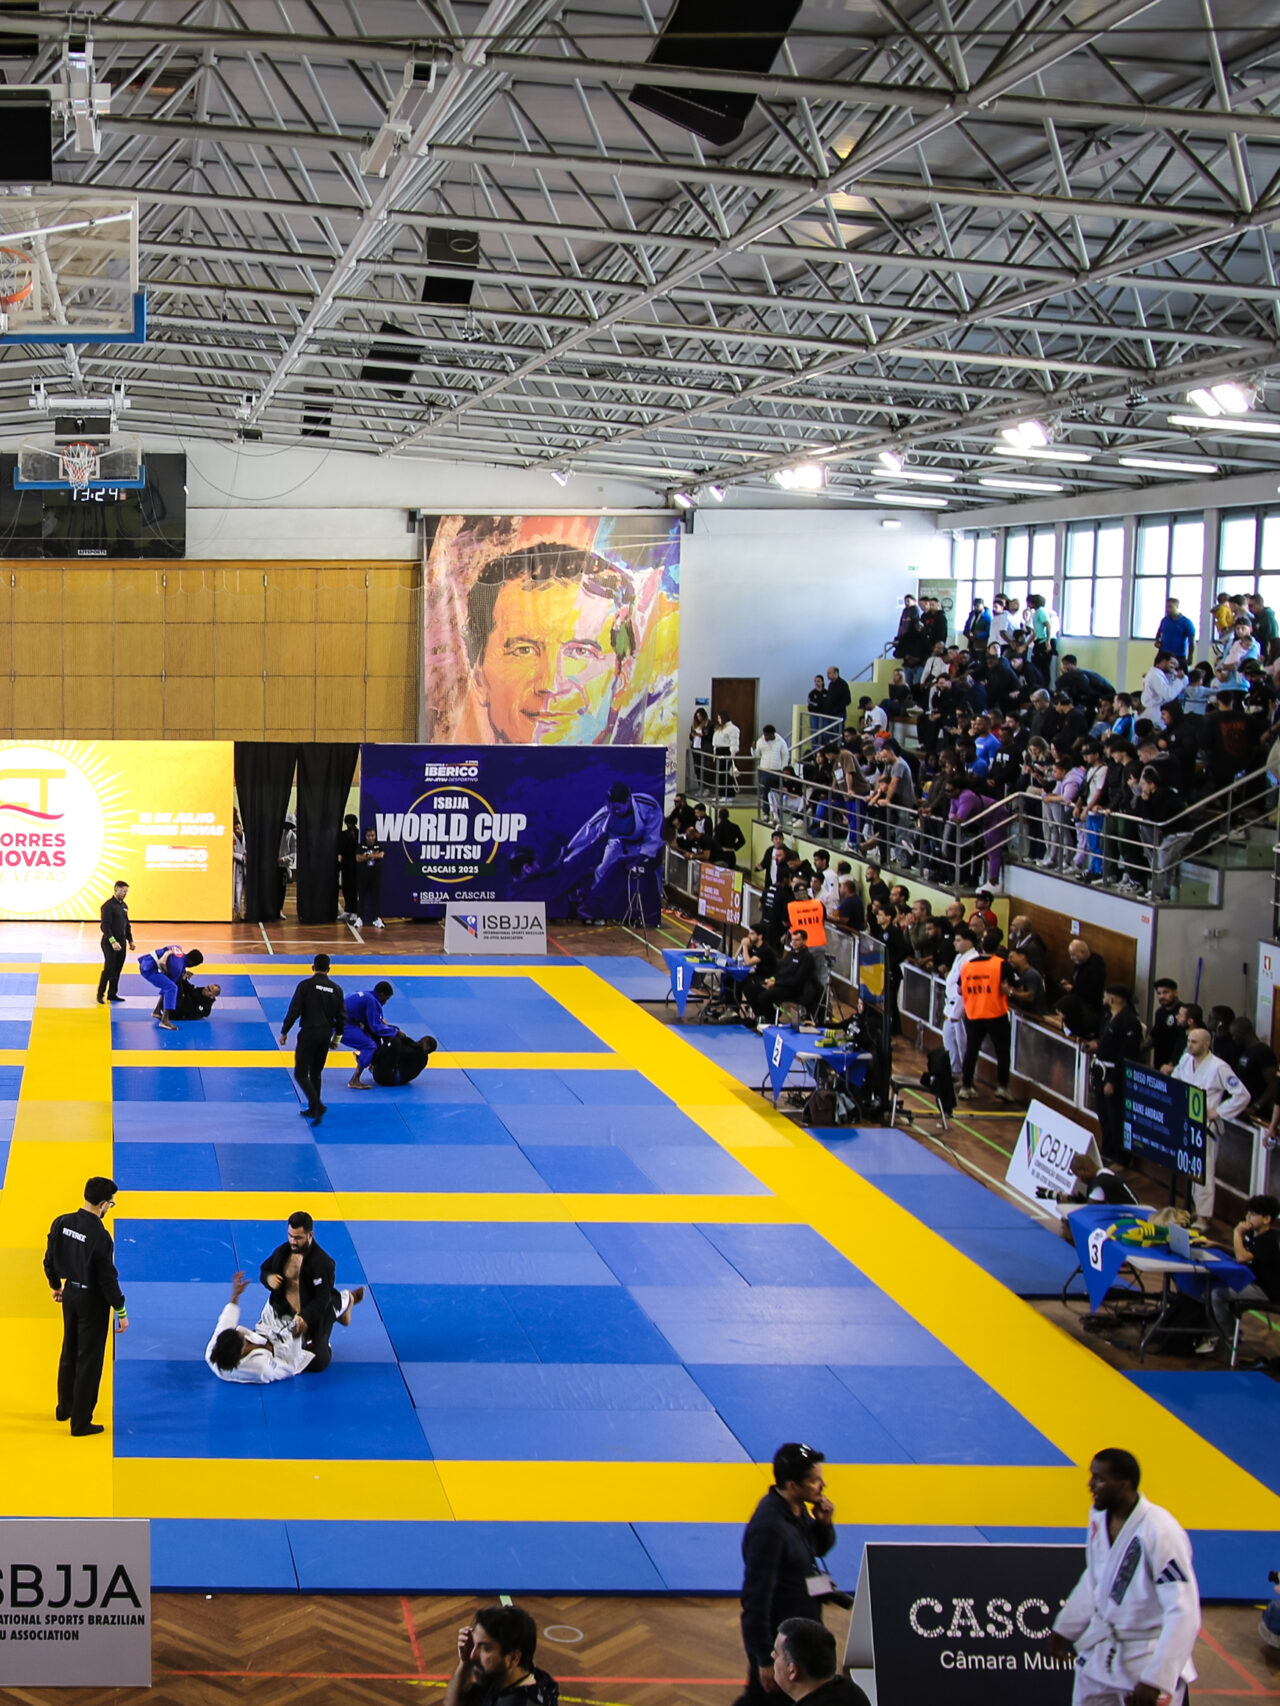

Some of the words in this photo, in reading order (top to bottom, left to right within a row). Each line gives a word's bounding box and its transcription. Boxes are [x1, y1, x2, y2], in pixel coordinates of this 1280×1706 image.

[433, 796, 470, 810] ISBJJA
[180, 824, 225, 836] NOVAS
[375, 813, 469, 842] WORLD
[474, 812, 528, 842] CUP
[420, 844, 482, 860] JIU-JITSU
[421, 865, 457, 873] CASCAIS
[458, 865, 479, 873] 2025
[419, 891, 450, 901] ISBJJA
[454, 891, 496, 900] CASCAIS
[482, 915, 543, 930] ISBJJA
[797, 916, 820, 926] MEDIA
[1192, 1092, 1201, 1117] 0
[1190, 1126, 1203, 1149] 16
[1040, 1133, 1075, 1177] CBJJ
[1176, 1148, 1203, 1179] 00:49
[62, 1227, 87, 1243] REFEREE
[1091, 1243, 1099, 1265] 3
[44, 1614, 84, 1626] SPORTS
[87, 1614, 145, 1626] BRAZILIAN
[909, 1597, 1067, 1639] CASC
[10, 1629, 80, 1641] ASSOCIATION
[940, 1650, 1017, 1670] Câmara
